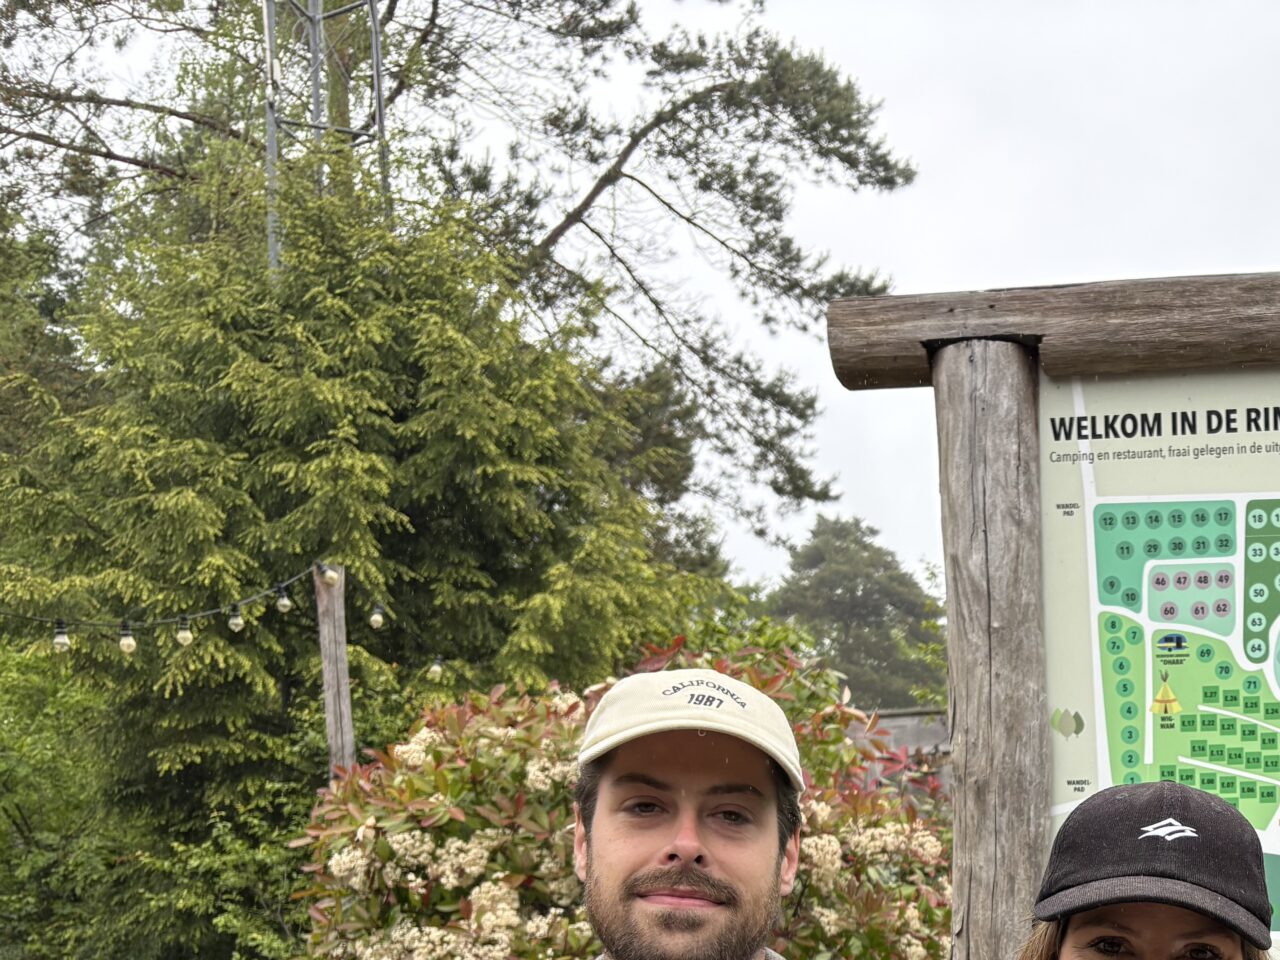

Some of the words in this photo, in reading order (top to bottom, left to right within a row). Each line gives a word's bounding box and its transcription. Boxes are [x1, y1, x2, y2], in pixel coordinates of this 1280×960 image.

[1050, 412, 1162, 441] WELKOM
[1170, 410, 1197, 436] IN
[1206, 408, 1238, 434] DE
[1050, 451, 1095, 465] Camping
[1097, 452, 1110, 461] en
[1112, 448, 1166, 460] restaurant,
[1168, 446, 1190, 458] fraai
[1193, 443, 1234, 458] gelegen
[1236, 443, 1248, 454] in
[1249, 442, 1263, 454] de
[1126, 516, 1136, 525] 13
[1172, 514, 1182, 523] 15
[1196, 541, 1206, 550] 31
[1120, 546, 1130, 555] 11
[1176, 576, 1187, 585] 47
[1218, 574, 1229, 584] 49
[1109, 581, 1115, 590] 9
[1216, 603, 1227, 612] 62
[1251, 644, 1262, 653] 64
[1119, 662, 1125, 670] 6
[1247, 681, 1257, 689] 71
[662, 679, 747, 709] CALIFORNIA
[687, 692, 724, 709] 1987
